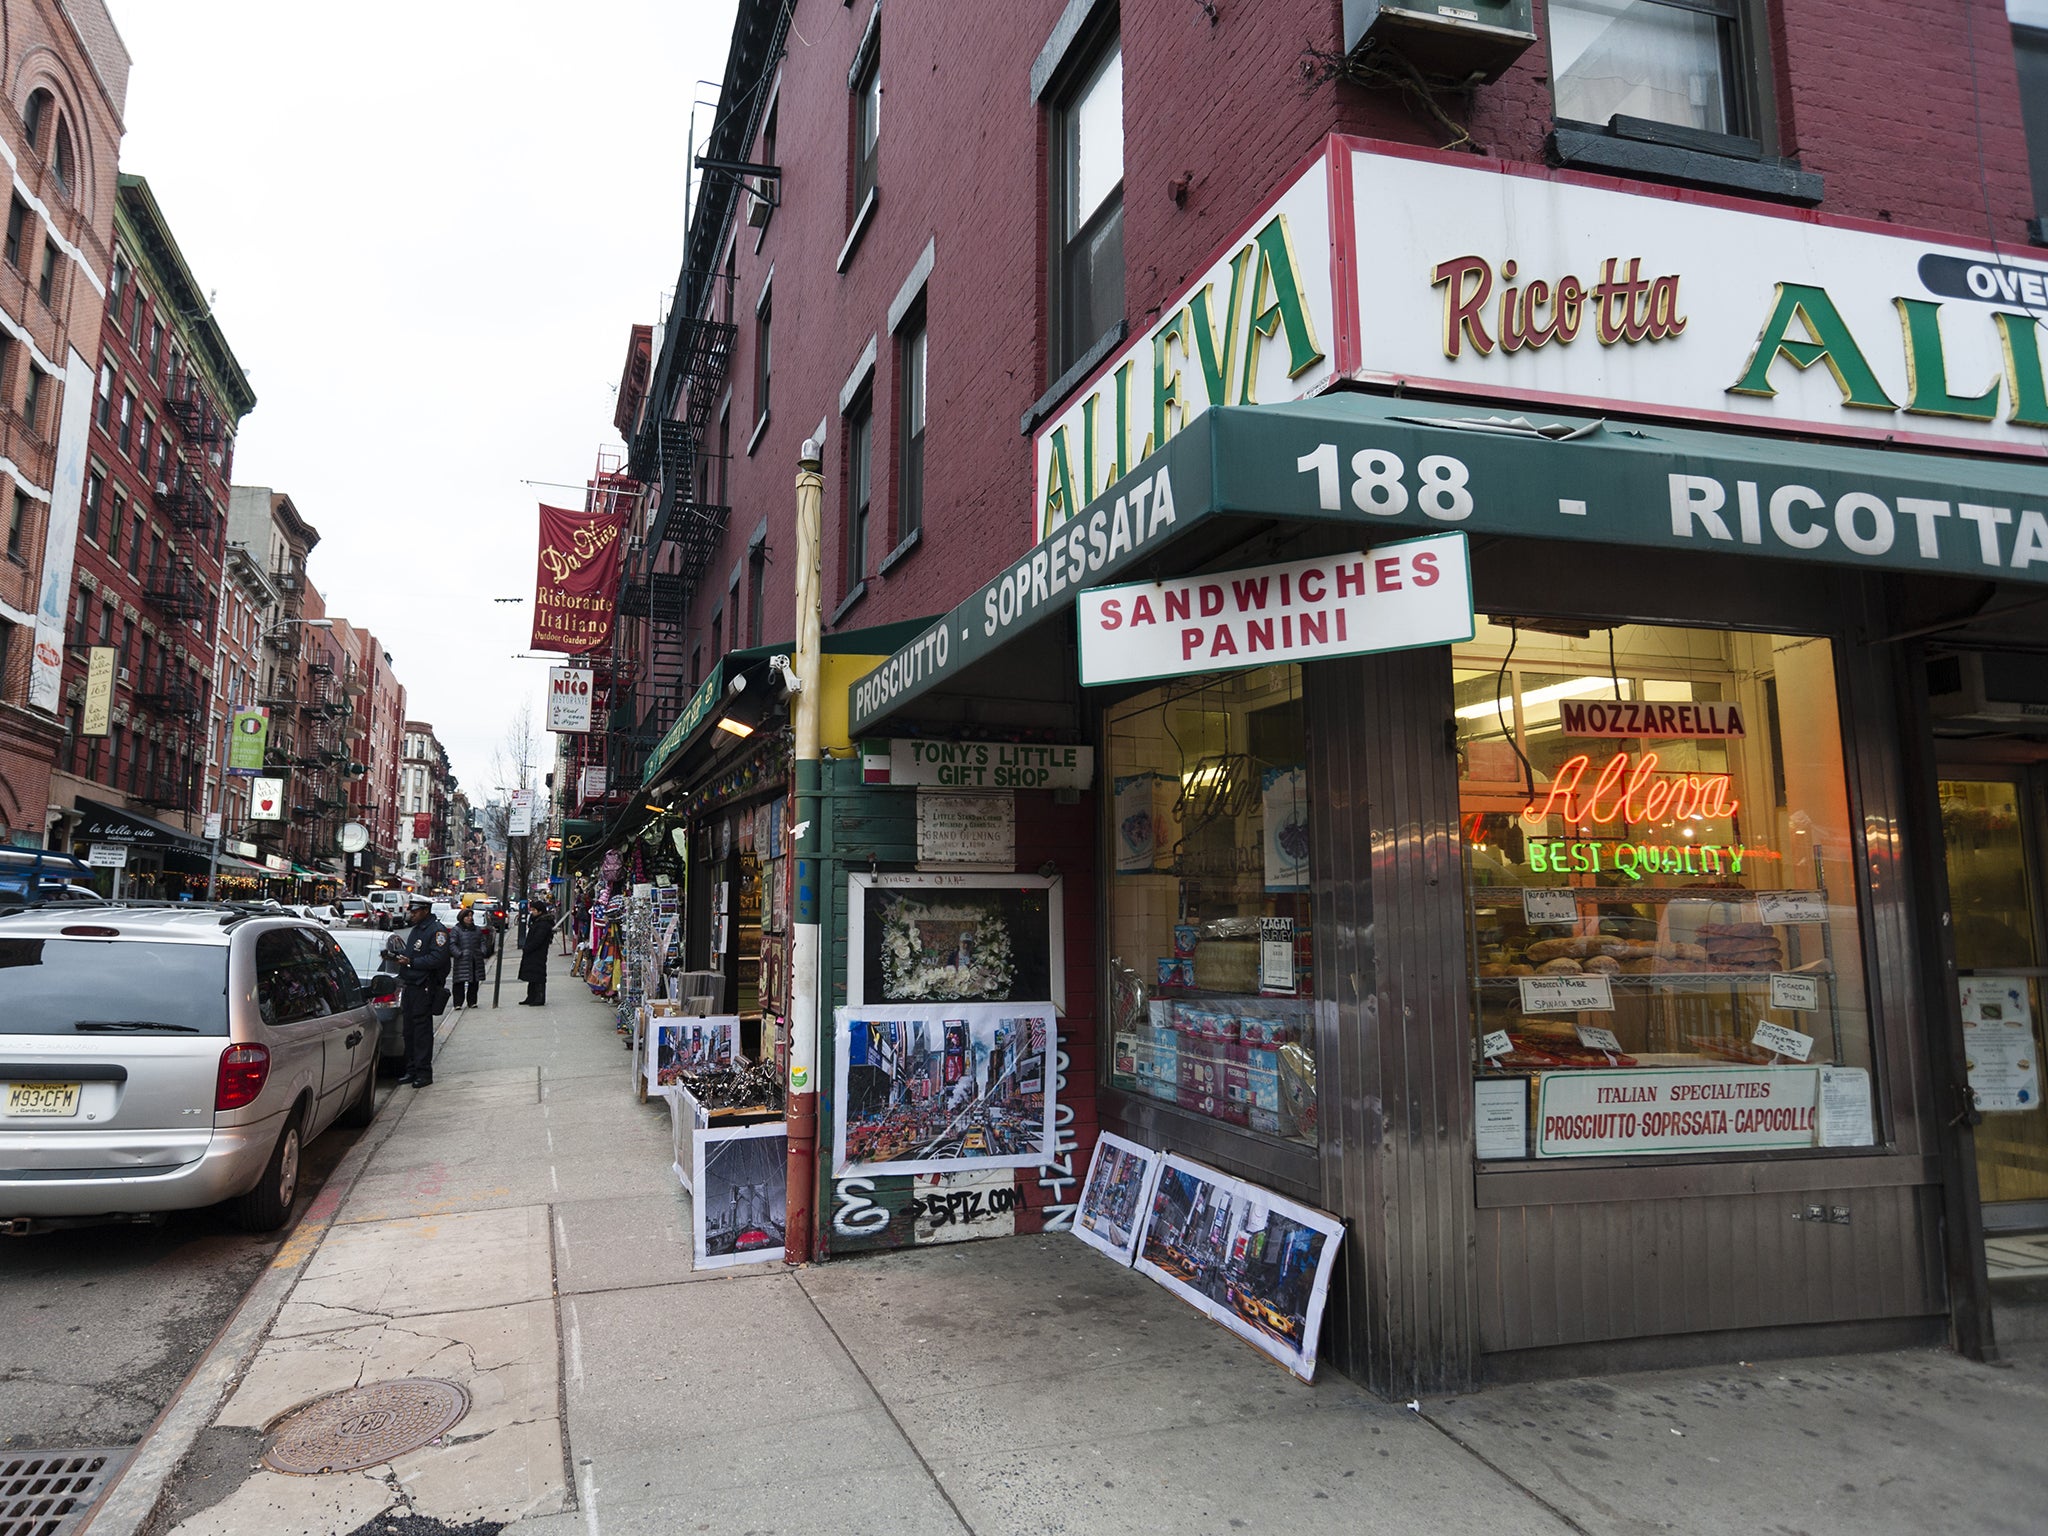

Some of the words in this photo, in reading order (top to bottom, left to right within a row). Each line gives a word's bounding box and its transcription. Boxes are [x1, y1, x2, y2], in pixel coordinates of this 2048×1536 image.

[1967, 265, 2048, 306] OVE
[1431, 254, 1688, 361] Ricotta
[1043, 213, 1325, 540] ALLEVA
[1296, 442, 1475, 521] 188
[1667, 472, 2048, 570] RICOTTA
[540, 544, 581, 585] Da
[538, 586, 614, 612] Ristorante
[855, 622, 949, 722] PROSCIUTTO
[984, 464, 1178, 638] SOPRESSATA
[1099, 552, 1441, 631] SANDWICHES
[539, 608, 608, 634] Italiano
[534, 630, 562, 642] Outdoor
[562, 633, 587, 645] Garden
[1182, 608, 1348, 661] PANINI
[563, 670, 580, 680] DA
[553, 679, 589, 696] NICO
[1563, 703, 1745, 735] MOZZARELLA
[911, 742, 989, 765] TONY'S
[999, 746, 1077, 768] LITTLE
[257, 780, 271, 791] LA
[937, 764, 987, 786] GIFT
[993, 766, 1049, 788] SHOP
[1522, 752, 1740, 825] Alleva
[88, 823, 103, 834] la
[104, 824, 133, 836] bella
[134, 828, 156, 838] vita
[925, 830, 957, 841] GRAND
[960, 831, 1001, 841] OPENING
[1528, 842, 1602, 874] BEST
[1614, 842, 1746, 881] QUALITY
[1261, 918, 1292, 931] ZAGAT
[1528, 911, 1546, 919] RICE
[1262, 930, 1293, 942] SURVEY
[1776, 979, 1811, 991] FOCACCIA
[1782, 992, 1806, 1001] PIZZA
[1534, 999, 1568, 1009] SPINACH
[1571, 997, 1599, 1008] BREAD
[1760, 1020, 1789, 1037] POTATO
[1597, 1086, 1658, 1105] ITALIAN
[1670, 1082, 1771, 1101] SPECIALTIES
